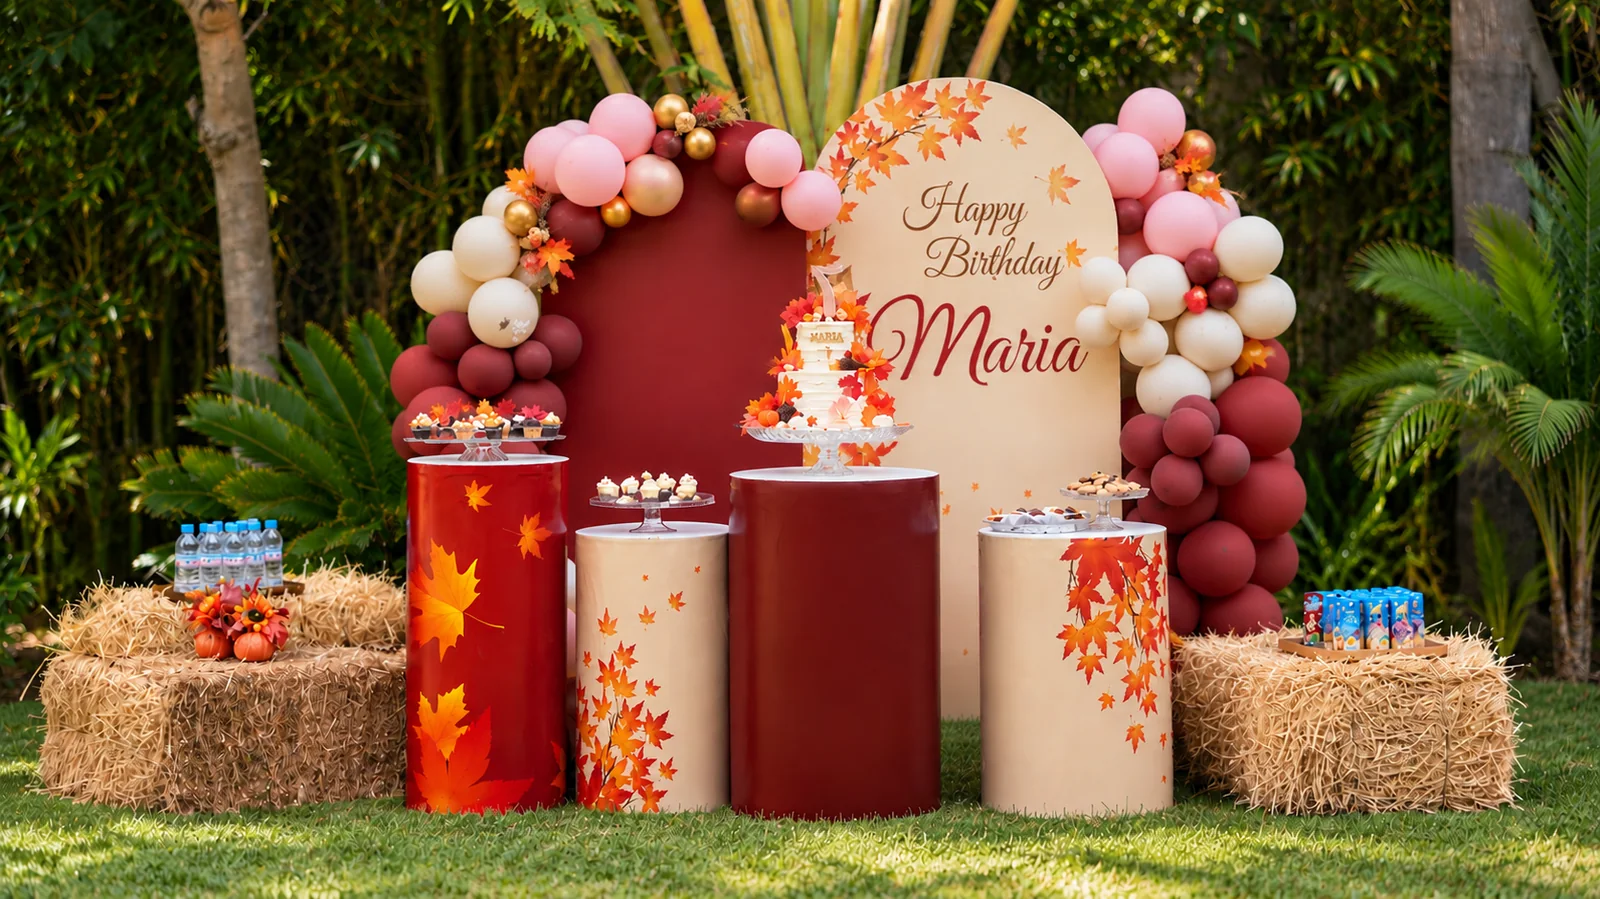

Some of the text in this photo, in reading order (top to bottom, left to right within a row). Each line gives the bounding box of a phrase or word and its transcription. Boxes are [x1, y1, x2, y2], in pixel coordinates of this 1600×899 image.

[903, 180, 1028, 237] Happy
[924, 235, 1064, 291] Birthday
[810, 332, 844, 344] MARIA
[867, 294, 1089, 386] Maria
